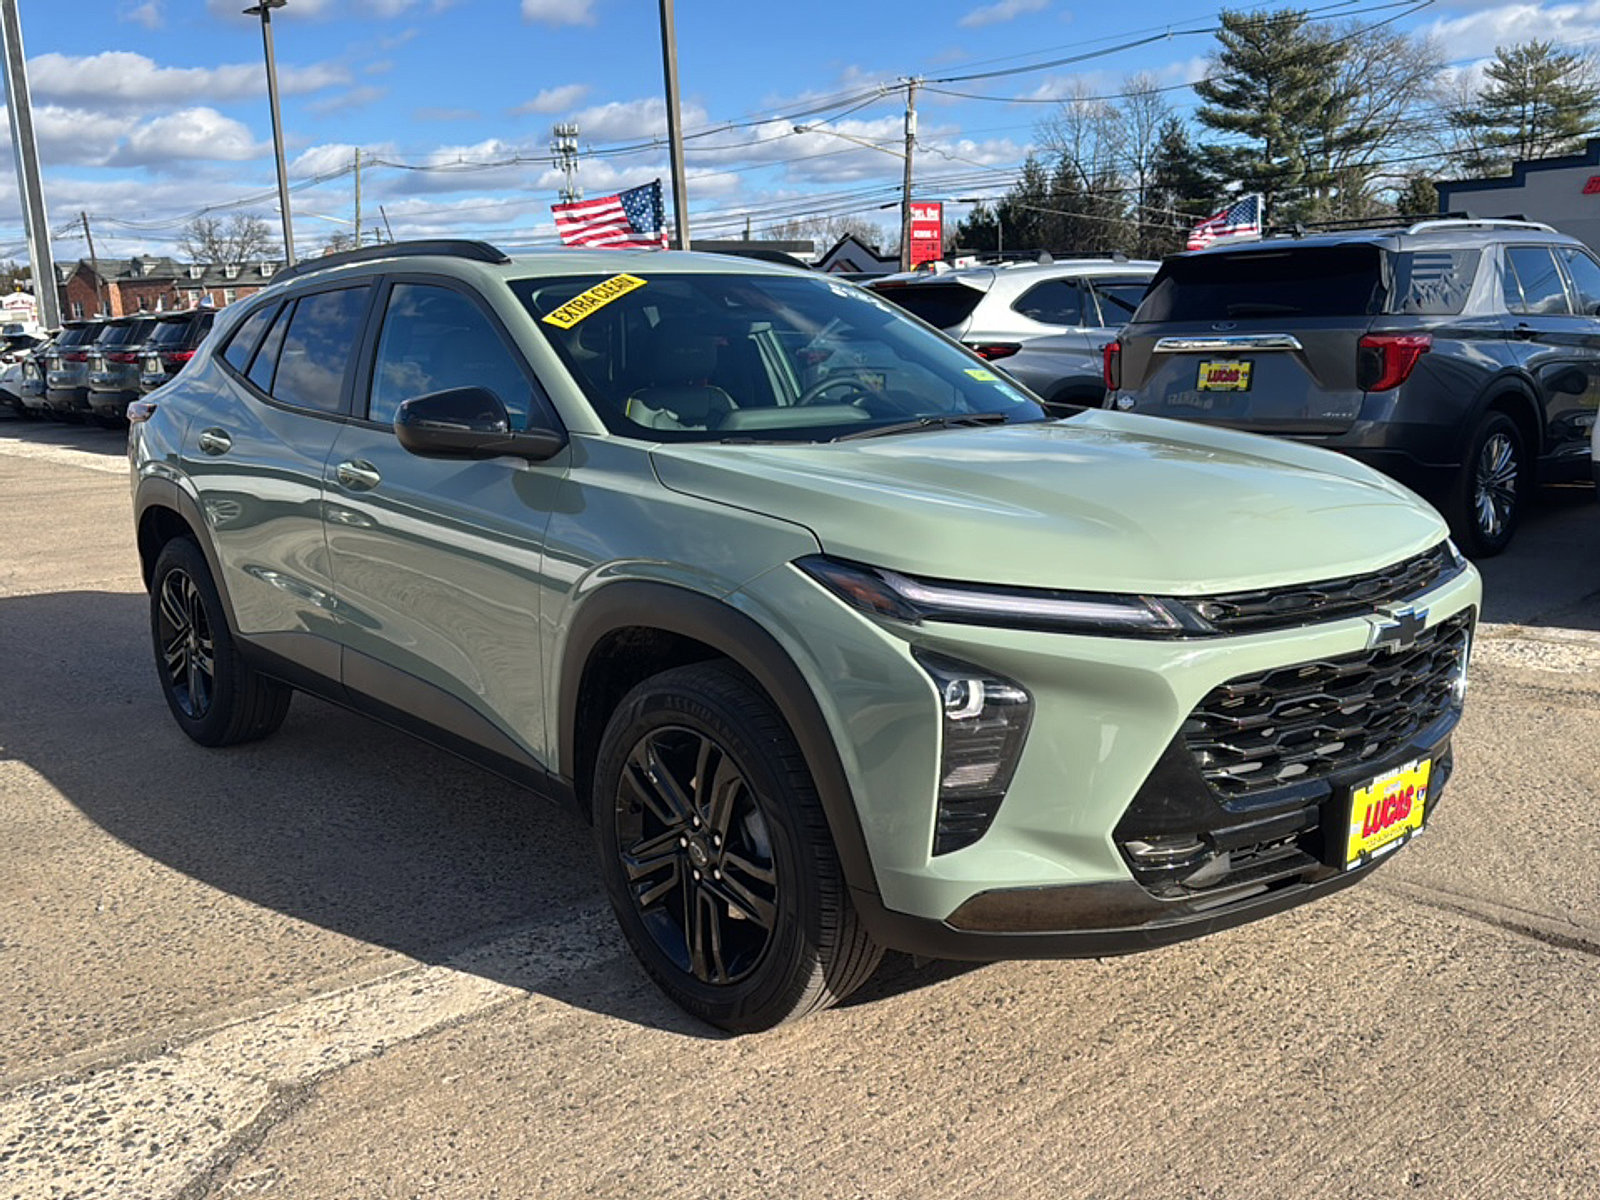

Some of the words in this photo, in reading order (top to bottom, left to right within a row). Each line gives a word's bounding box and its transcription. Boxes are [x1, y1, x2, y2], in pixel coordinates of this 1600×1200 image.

[552, 294, 601, 323] EXTRA
[591, 276, 635, 299] CLEAN
[1207, 368, 1240, 382] LUCAS
[1362, 784, 1414, 838] LUCAS
